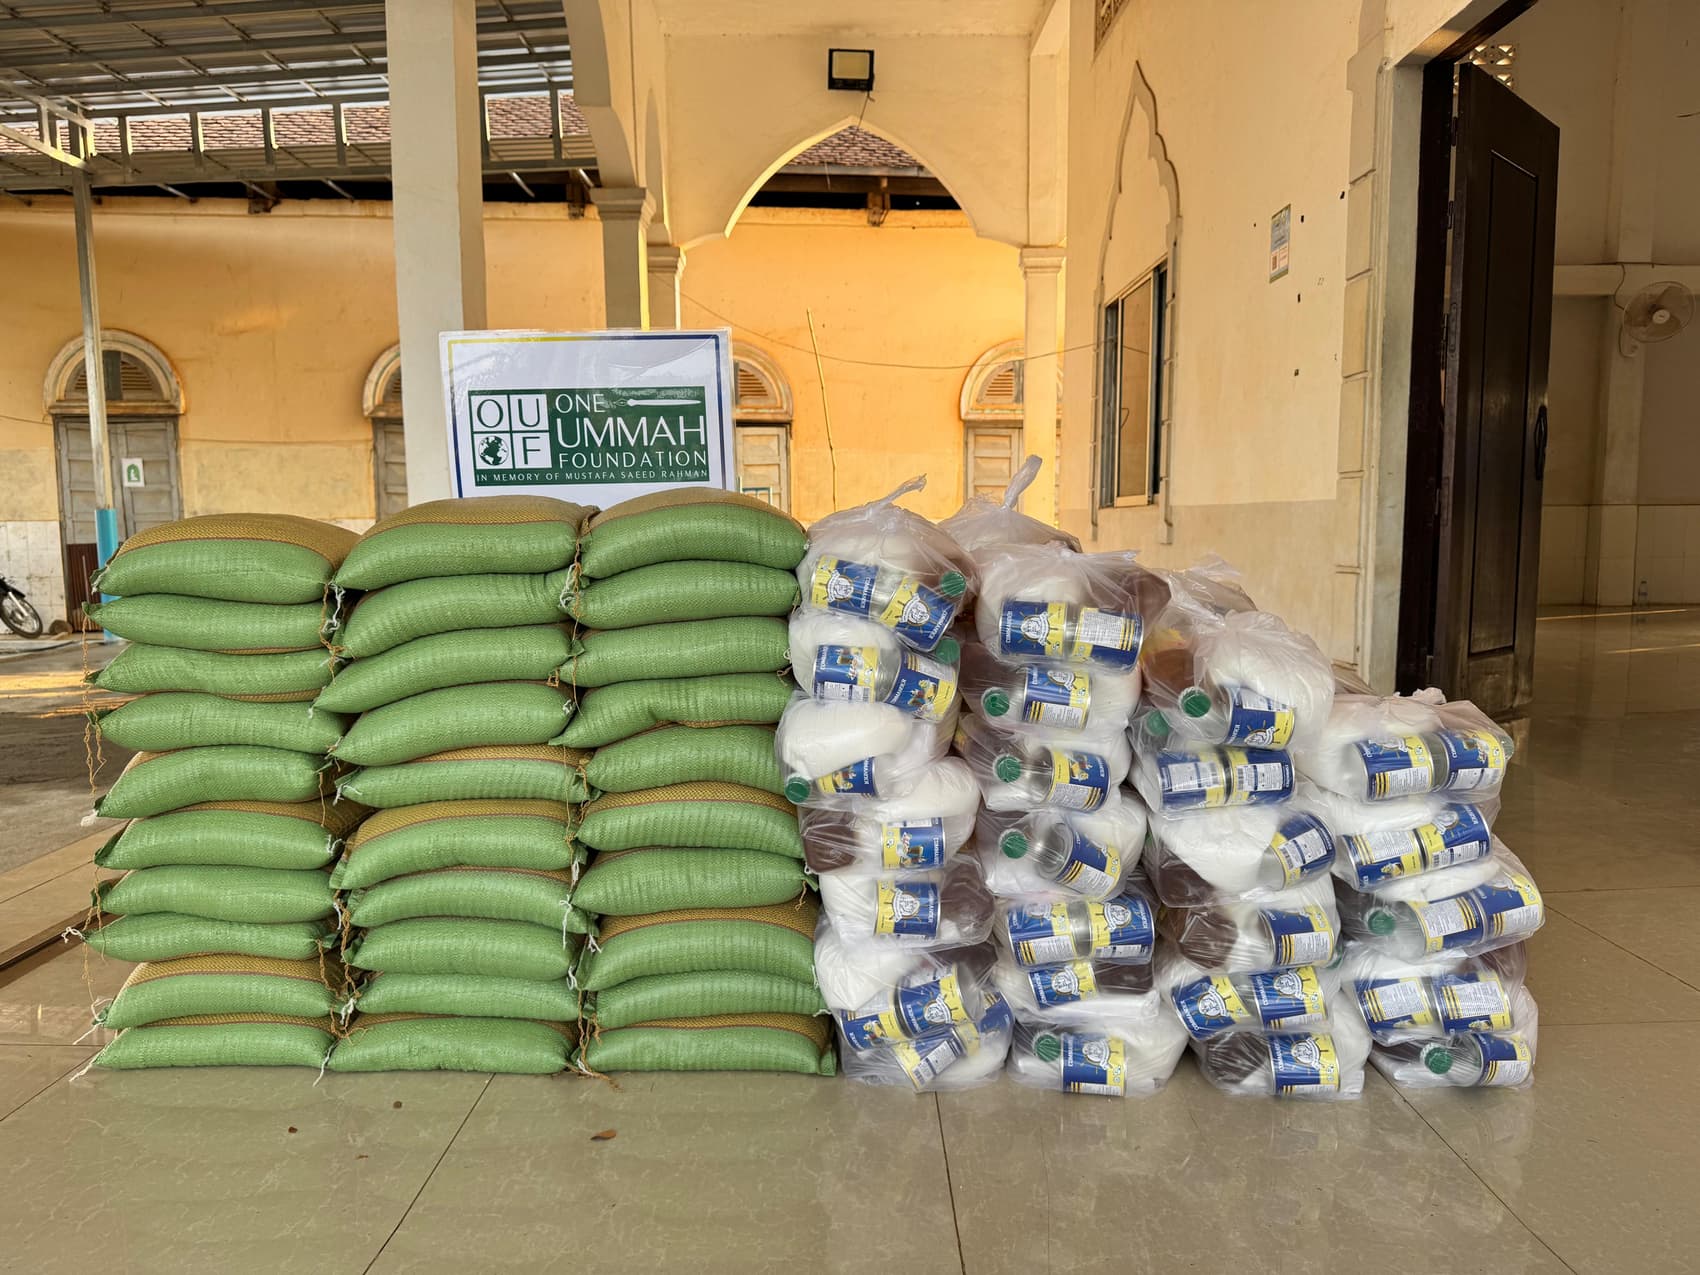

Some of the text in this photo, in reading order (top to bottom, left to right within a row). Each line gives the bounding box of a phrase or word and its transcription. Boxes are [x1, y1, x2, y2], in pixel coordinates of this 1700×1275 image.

[555, 393, 606, 413] ONE
[556, 415, 706, 448] UMMAH
[559, 450, 706, 469] FOUNDATION
[476, 469, 708, 482] IN MEMORY OF MUSTAFA SAEED RAHMAN
